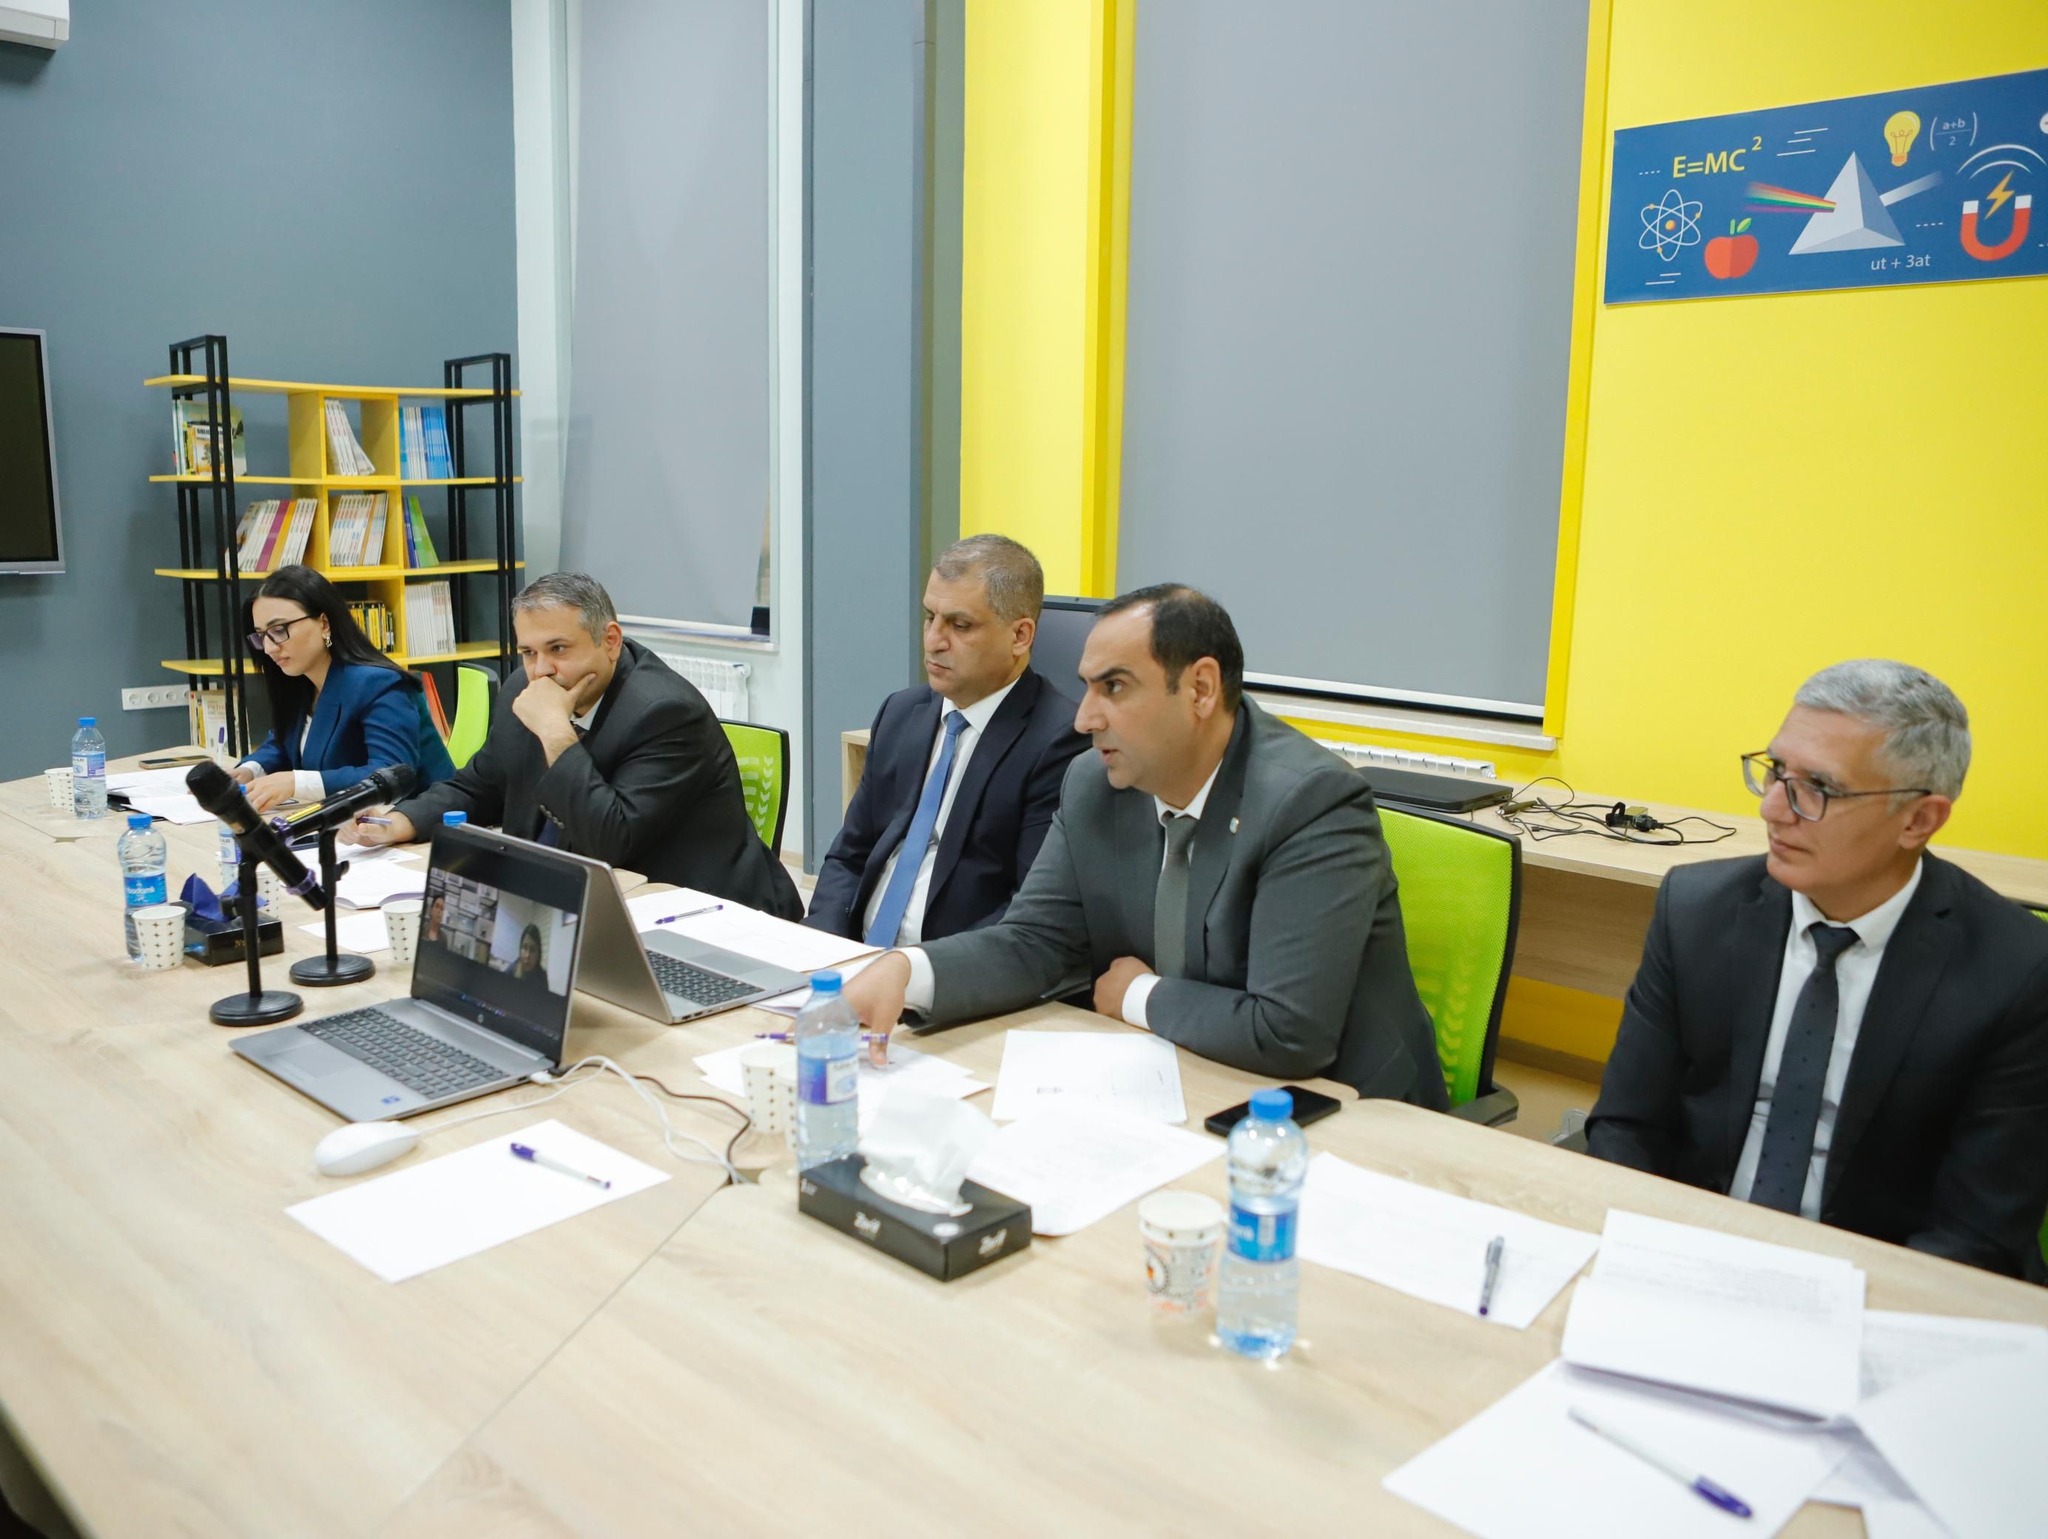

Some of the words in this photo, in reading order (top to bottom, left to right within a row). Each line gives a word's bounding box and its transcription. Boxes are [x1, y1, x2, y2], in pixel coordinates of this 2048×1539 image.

[1673, 148, 1746, 178] E=MC
[1751, 135, 1762, 151] 2
[1871, 257, 1887, 270] ut
[1906, 254, 1931, 268] 3at
